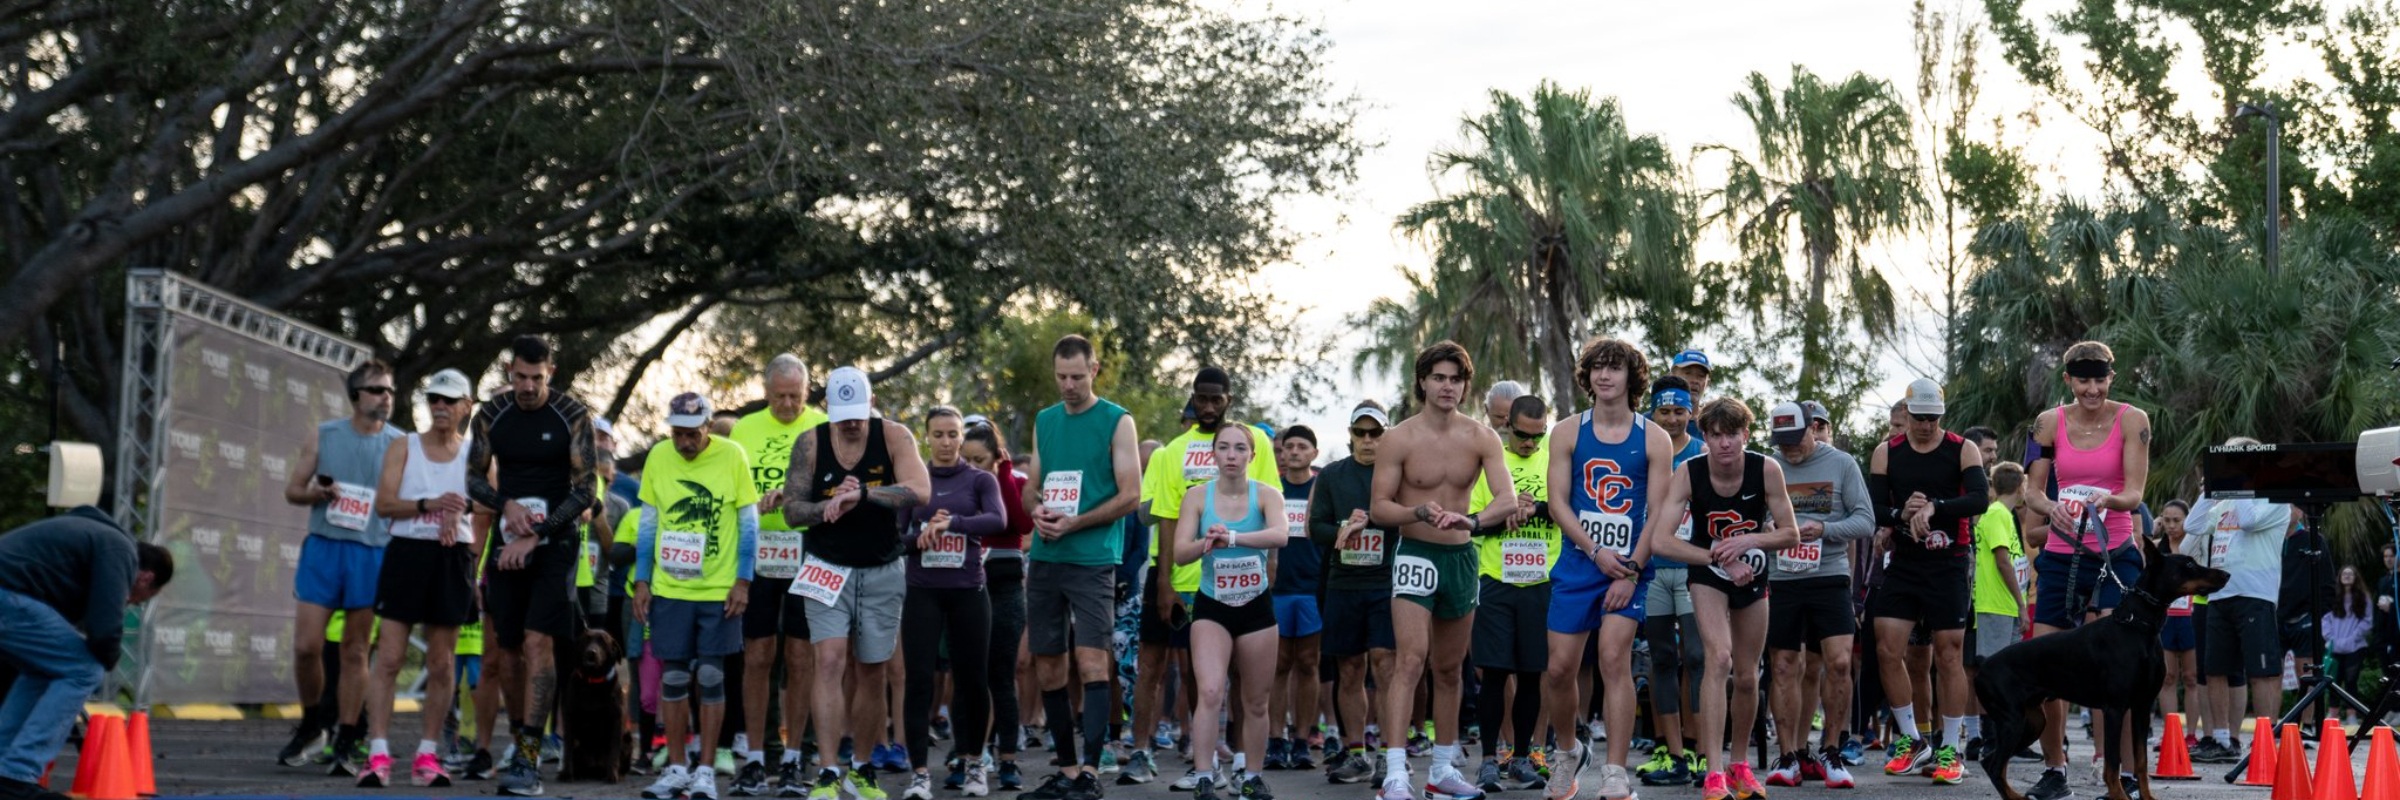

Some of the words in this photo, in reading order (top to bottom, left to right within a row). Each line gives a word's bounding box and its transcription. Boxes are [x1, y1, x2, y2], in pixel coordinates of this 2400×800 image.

[2246, 443, 2277, 452] SPORTS
[751, 466, 788, 480] TO
[1043, 488, 1078, 502] 5738
[331, 497, 370, 515] 7094
[932, 535, 964, 553] 060
[1347, 535, 1382, 551] 012
[661, 547, 700, 564] 5759
[758, 547, 797, 560] 5741
[1504, 553, 1546, 566] 5996
[798, 564, 844, 591] 7098
[1216, 573, 1261, 589] 5789
